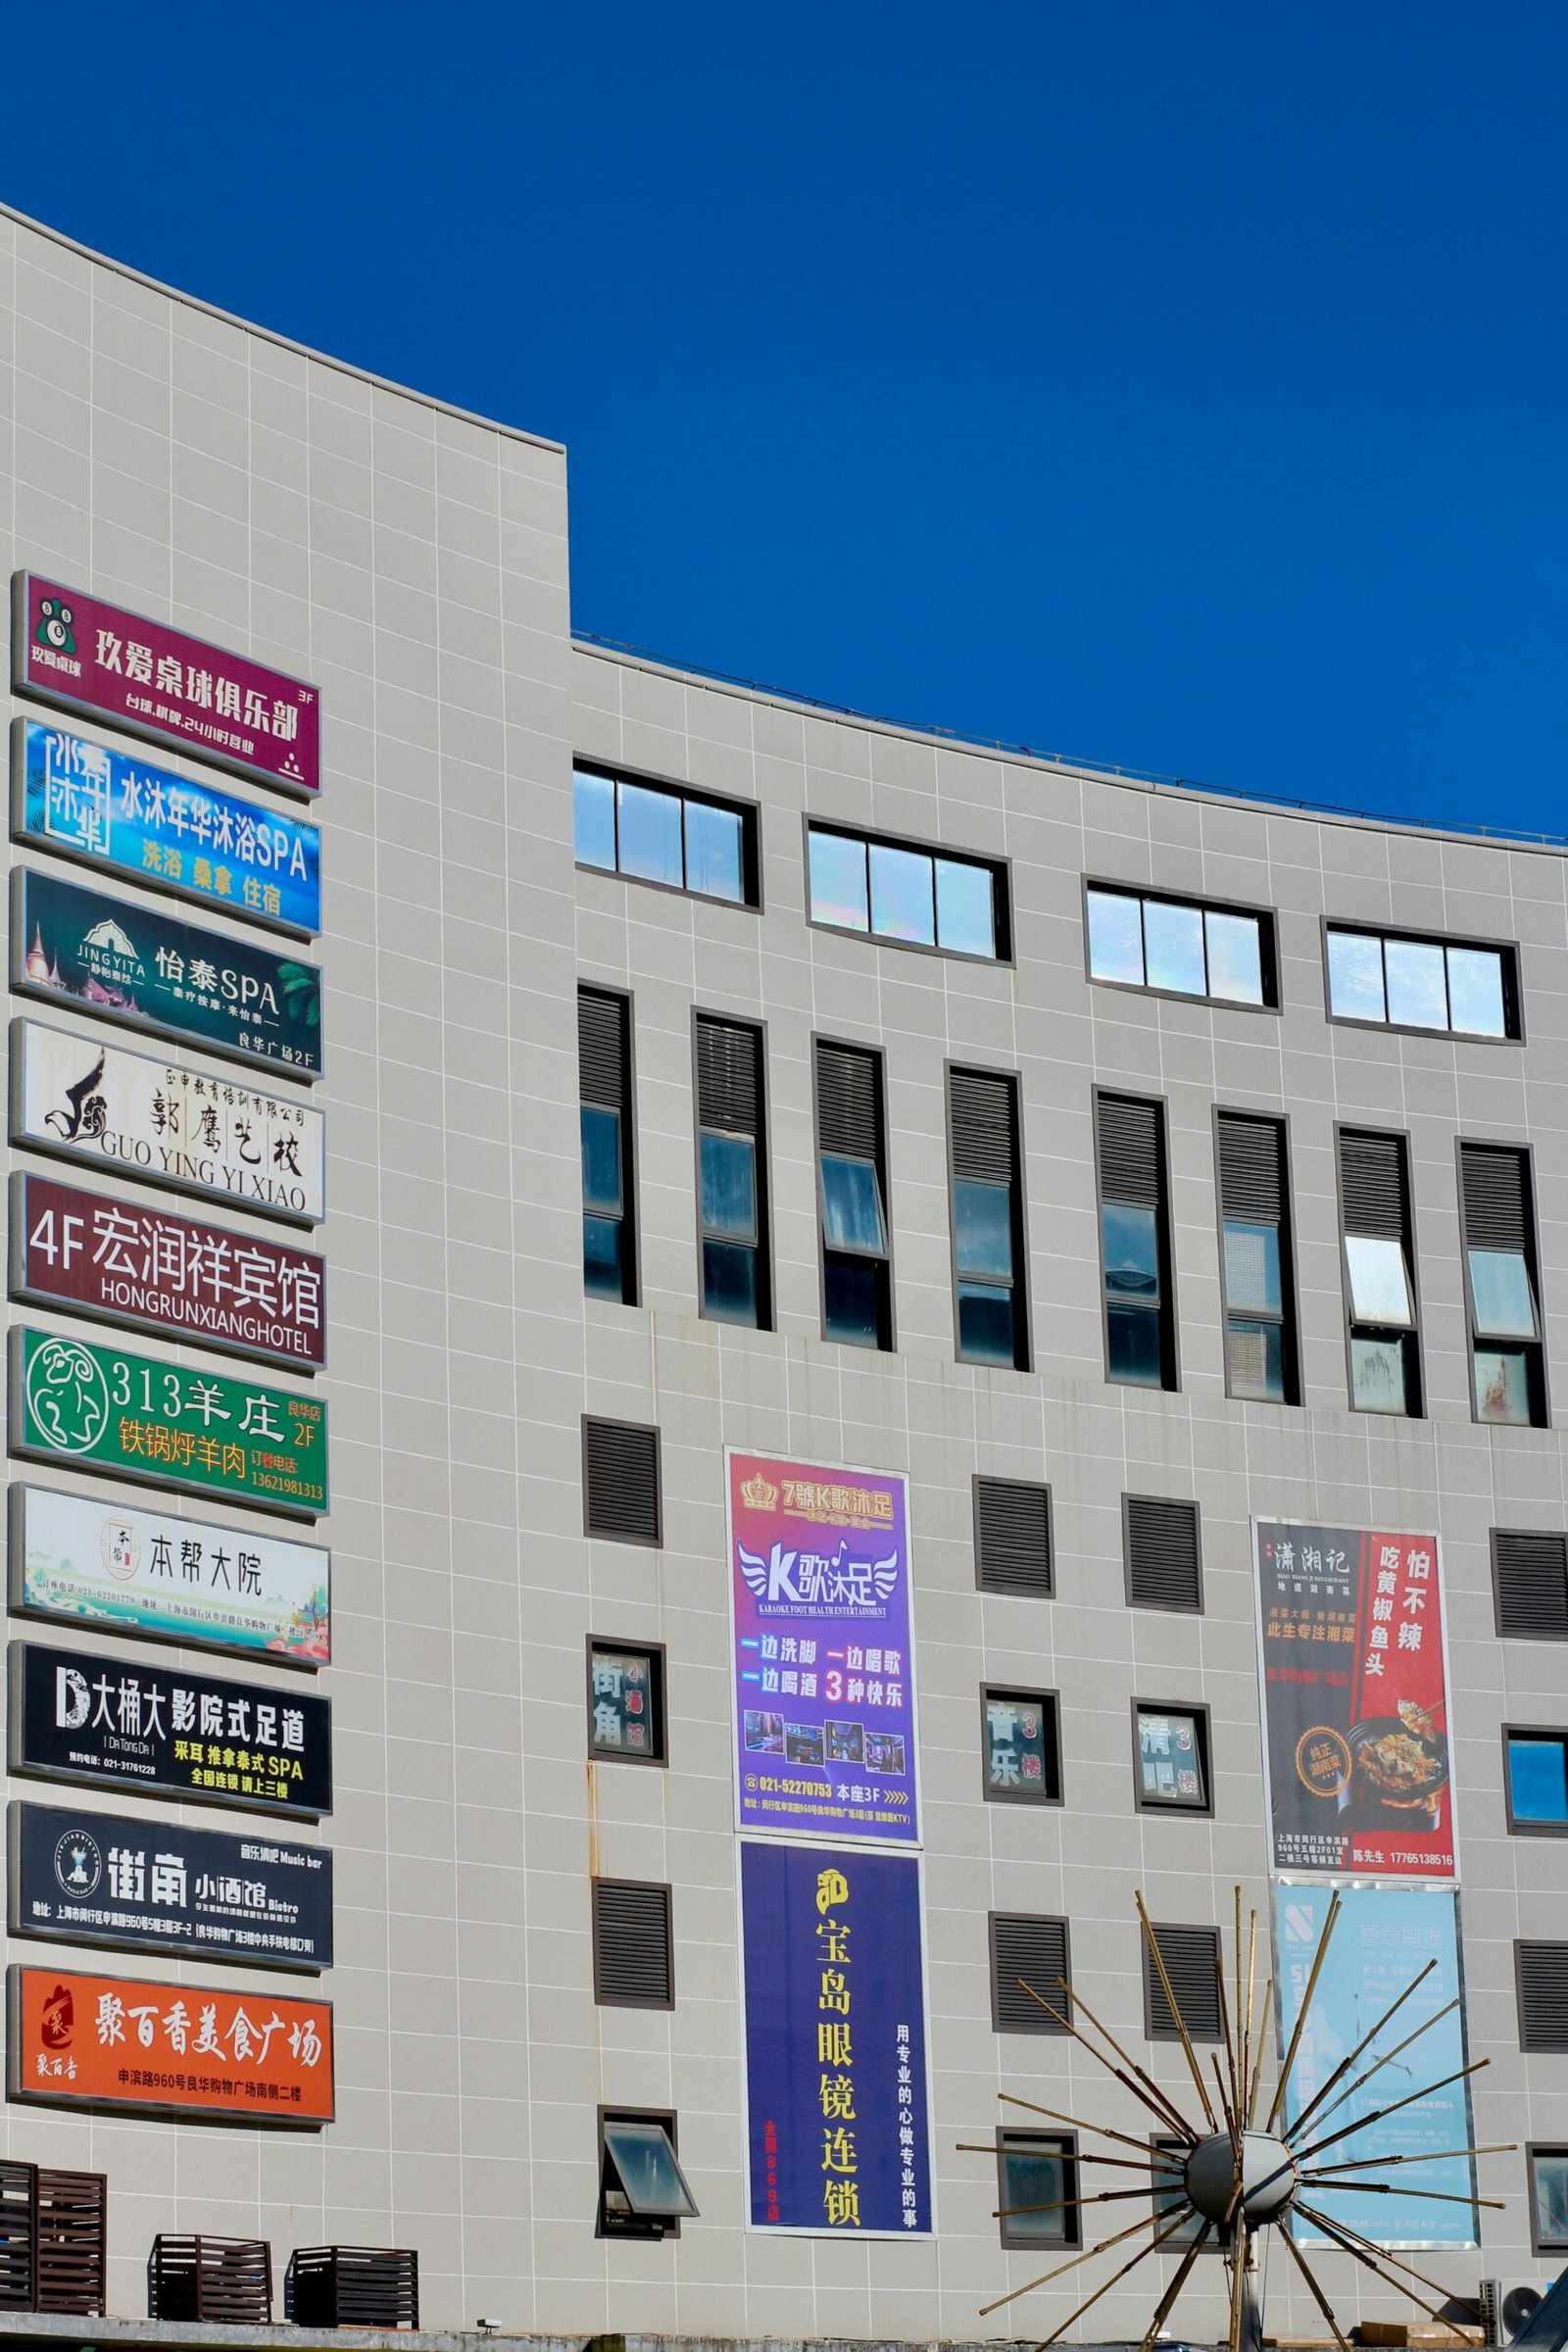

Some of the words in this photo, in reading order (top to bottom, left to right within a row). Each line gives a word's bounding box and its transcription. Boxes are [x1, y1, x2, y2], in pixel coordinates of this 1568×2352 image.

[31, 645, 81, 677] 玖爱桌球
[95, 629, 298, 742] 玖爱桌球俱乐部
[298, 690, 314, 704] 3F
[121, 771, 308, 881] 水沐年华沐浴SPA
[142, 838, 182, 880] 洗浴
[193, 857, 232, 896] 桑拿
[242, 874, 281, 916] 住宿
[77, 945, 146, 978] JINGYITA
[155, 946, 280, 1015] 怡泰SPA
[239, 1032, 314, 1067] 良华广场2F
[101, 1130, 151, 1166] GUO
[158, 1147, 215, 1185] YING
[221, 1165, 244, 1194] YI
[252, 1174, 306, 1212] XIAO
[101, 1277, 312, 1355] HONGRUNXIANGHOTEL
[288, 1400, 321, 1422] 良华店
[294, 1422, 315, 1446] 2F
[251, 1471, 323, 1500] 13621981313
[150, 1534, 263, 1596] 本帮大院
[1275, 1541, 1350, 1574] 潇湘记
[1365, 1546, 1399, 1677] 吃黄椒鱼头
[1397, 1549, 1431, 1651] 怕不辣
[1267, 1622, 1355, 1642] 此生专注湘菜
[741, 1635, 816, 1665] 一边洗脚
[827, 1645, 901, 1676] 一边唱歌
[741, 1668, 817, 1697] 一边喝酒
[825, 1671, 903, 1707] 3种快乐
[172, 1688, 305, 1752] 影院式足道
[174, 1740, 204, 1762] 采耳
[207, 1743, 265, 1775] 推拿泰式
[269, 1756, 303, 1781] SPA
[987, 1702, 1020, 1788] 音乐
[1021, 1712, 1042, 1780] 3楼
[1138, 1716, 1177, 1796] 清吧
[1176, 1725, 1198, 1794] 3楼
[104, 1758, 156, 1775] 021-31761228
[190, 1767, 238, 1791] 全国连锁
[241, 1775, 288, 1799] 请上三楼
[760, 1776, 832, 1798] 021-52270753
[836, 1783, 880, 1804] 本座3F
[240, 1843, 279, 1863] 音乐清吧
[280, 1850, 305, 1867] Music
[307, 1854, 322, 1869] bar
[1353, 1849, 1385, 1863] 陈先生
[1390, 1852, 1453, 1866] 17765138516
[195, 1873, 266, 1909] 小酒馆
[269, 1898, 299, 1914] Bistro
[95, 1991, 322, 2068] 聚百香美食广场
[36, 2053, 78, 2080] 聚百香
[119, 2068, 302, 2102] 申滨路960号良华购物广场南侧二楼
[816, 1919, 861, 2227] 宝岛眼镜连锁
[897, 2025, 917, 2229] 用专业的心做专业的事
